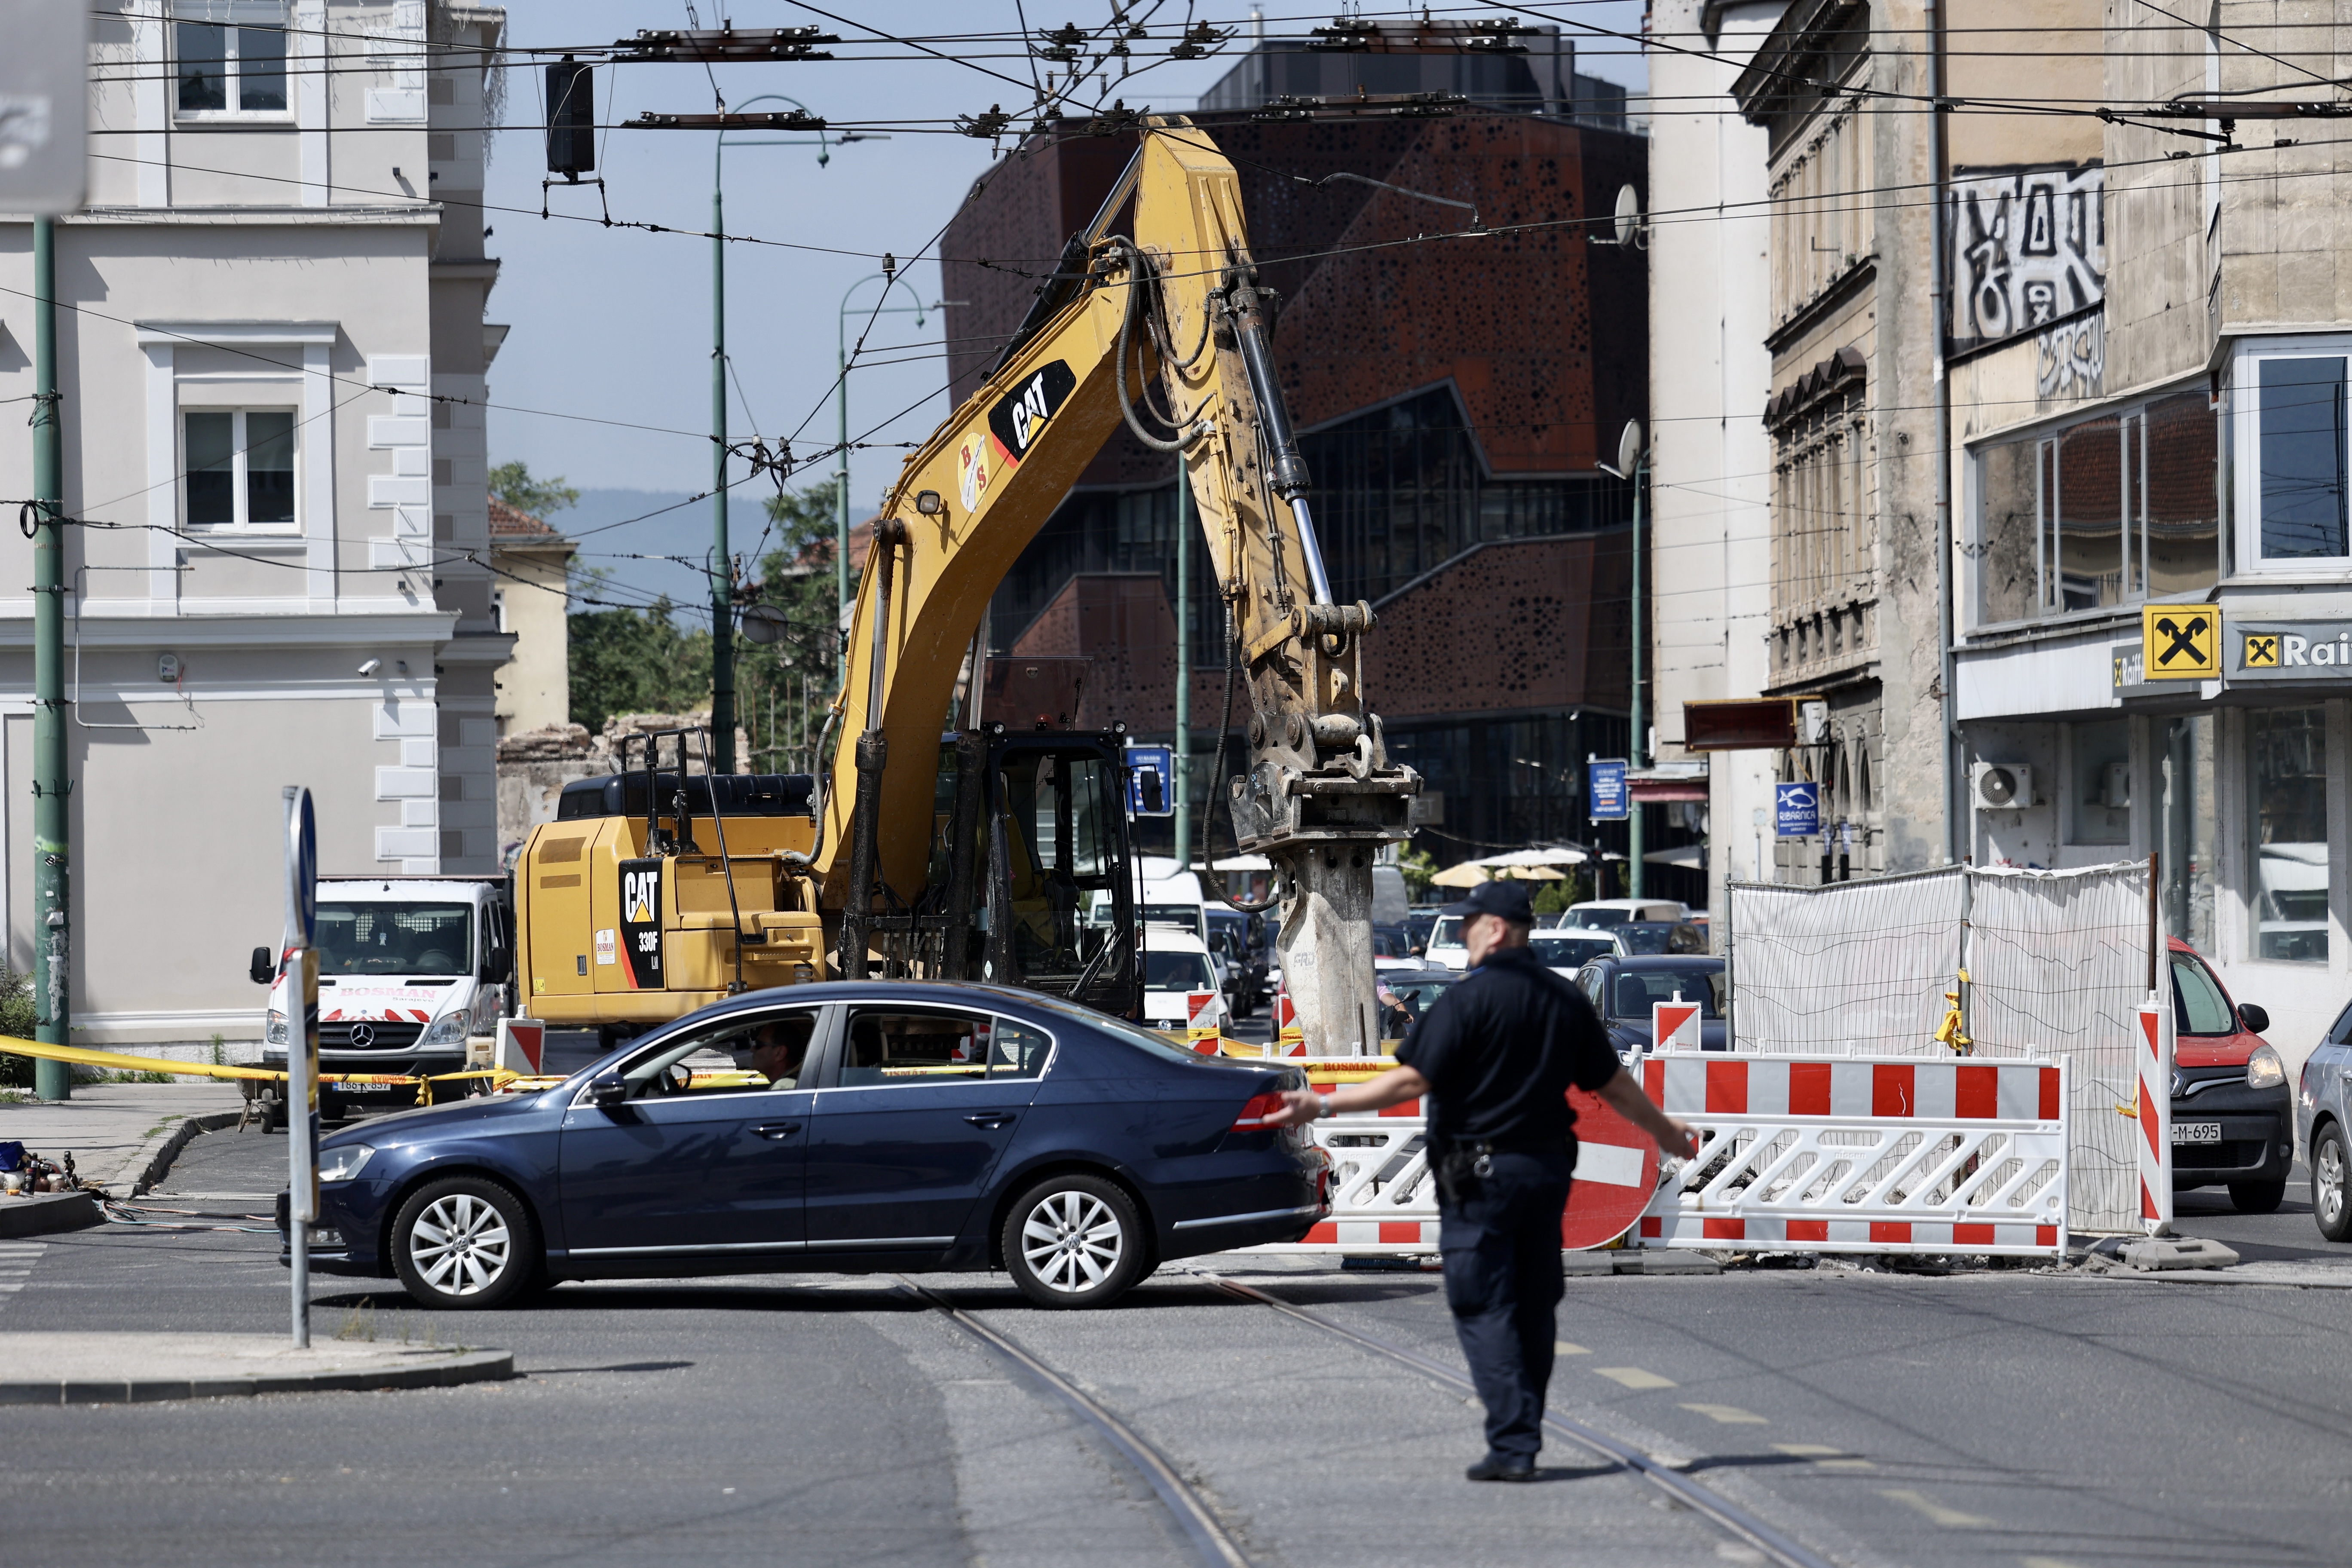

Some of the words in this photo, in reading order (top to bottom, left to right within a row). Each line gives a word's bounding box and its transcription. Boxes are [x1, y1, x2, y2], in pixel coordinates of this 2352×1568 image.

[1013, 372, 1048, 449] CAT
[2284, 632, 2352, 666] Rai
[625, 872, 658, 923] CAT
[597, 943, 614, 952] BOSMAN
[639, 931, 658, 952] 330F
[339, 988, 437, 998] BOSMAN
[1323, 1063, 1377, 1071] BOSMAN
[2170, 1125, 2218, 1139] -M-695
[1341, 1151, 1373, 1161] nissen
[1834, 1148, 1866, 1159] nissen
